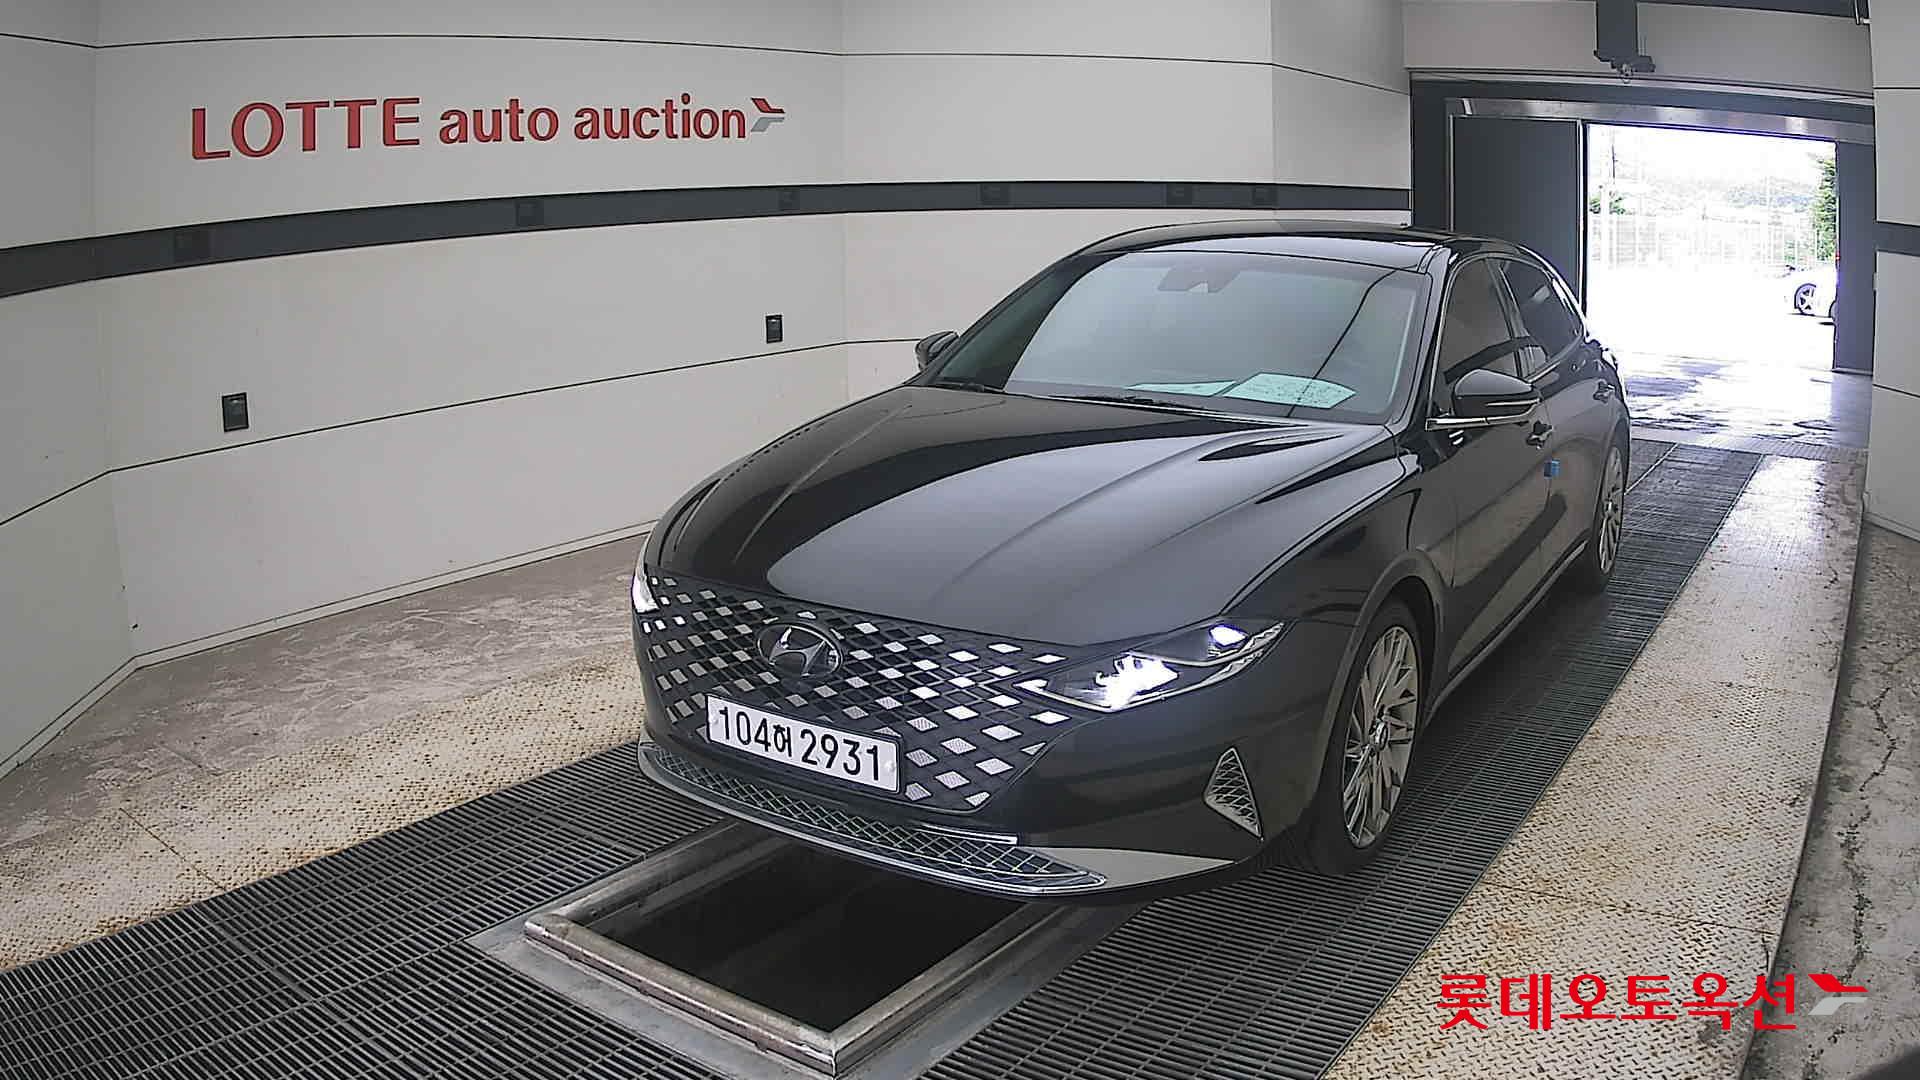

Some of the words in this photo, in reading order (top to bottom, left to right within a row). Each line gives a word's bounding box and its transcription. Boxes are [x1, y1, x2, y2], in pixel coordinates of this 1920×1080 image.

[191, 97, 420, 161] LOTTE
[438, 97, 560, 145] auto
[573, 93, 747, 141] auction
[719, 706, 793, 757] 104허
[800, 729, 879, 781] 2931
